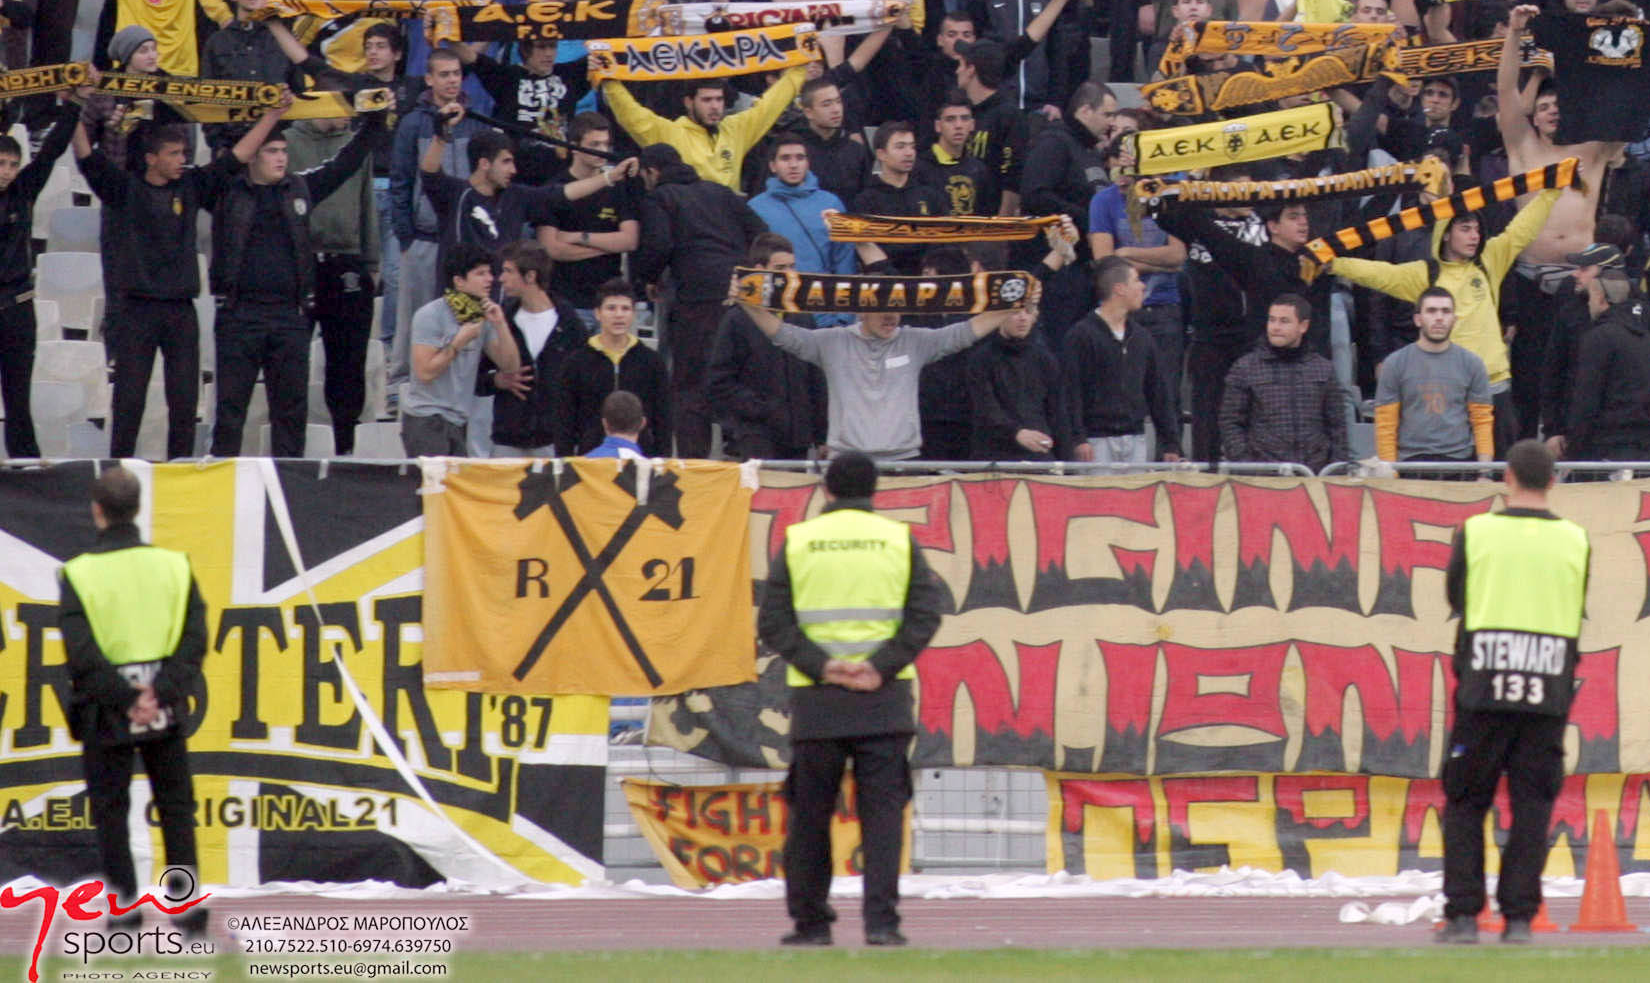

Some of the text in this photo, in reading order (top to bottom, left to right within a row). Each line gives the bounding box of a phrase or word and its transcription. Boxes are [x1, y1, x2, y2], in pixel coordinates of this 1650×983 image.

[627, 33, 788, 74] ΑΕΚΑΡΑ
[0, 71, 57, 92] ΝΩΣΗ
[103, 80, 249, 101] AEK ΕΝΩΣΗ
[1148, 121, 1321, 161] A.E.K A.E.K
[806, 280, 965, 308] ΑΕΚΑΡΑ
[808, 539, 888, 554] SECURITY
[515, 556, 701, 602] R 21
[1471, 631, 1568, 677] STEWARD
[1491, 673, 1545, 705] 133
